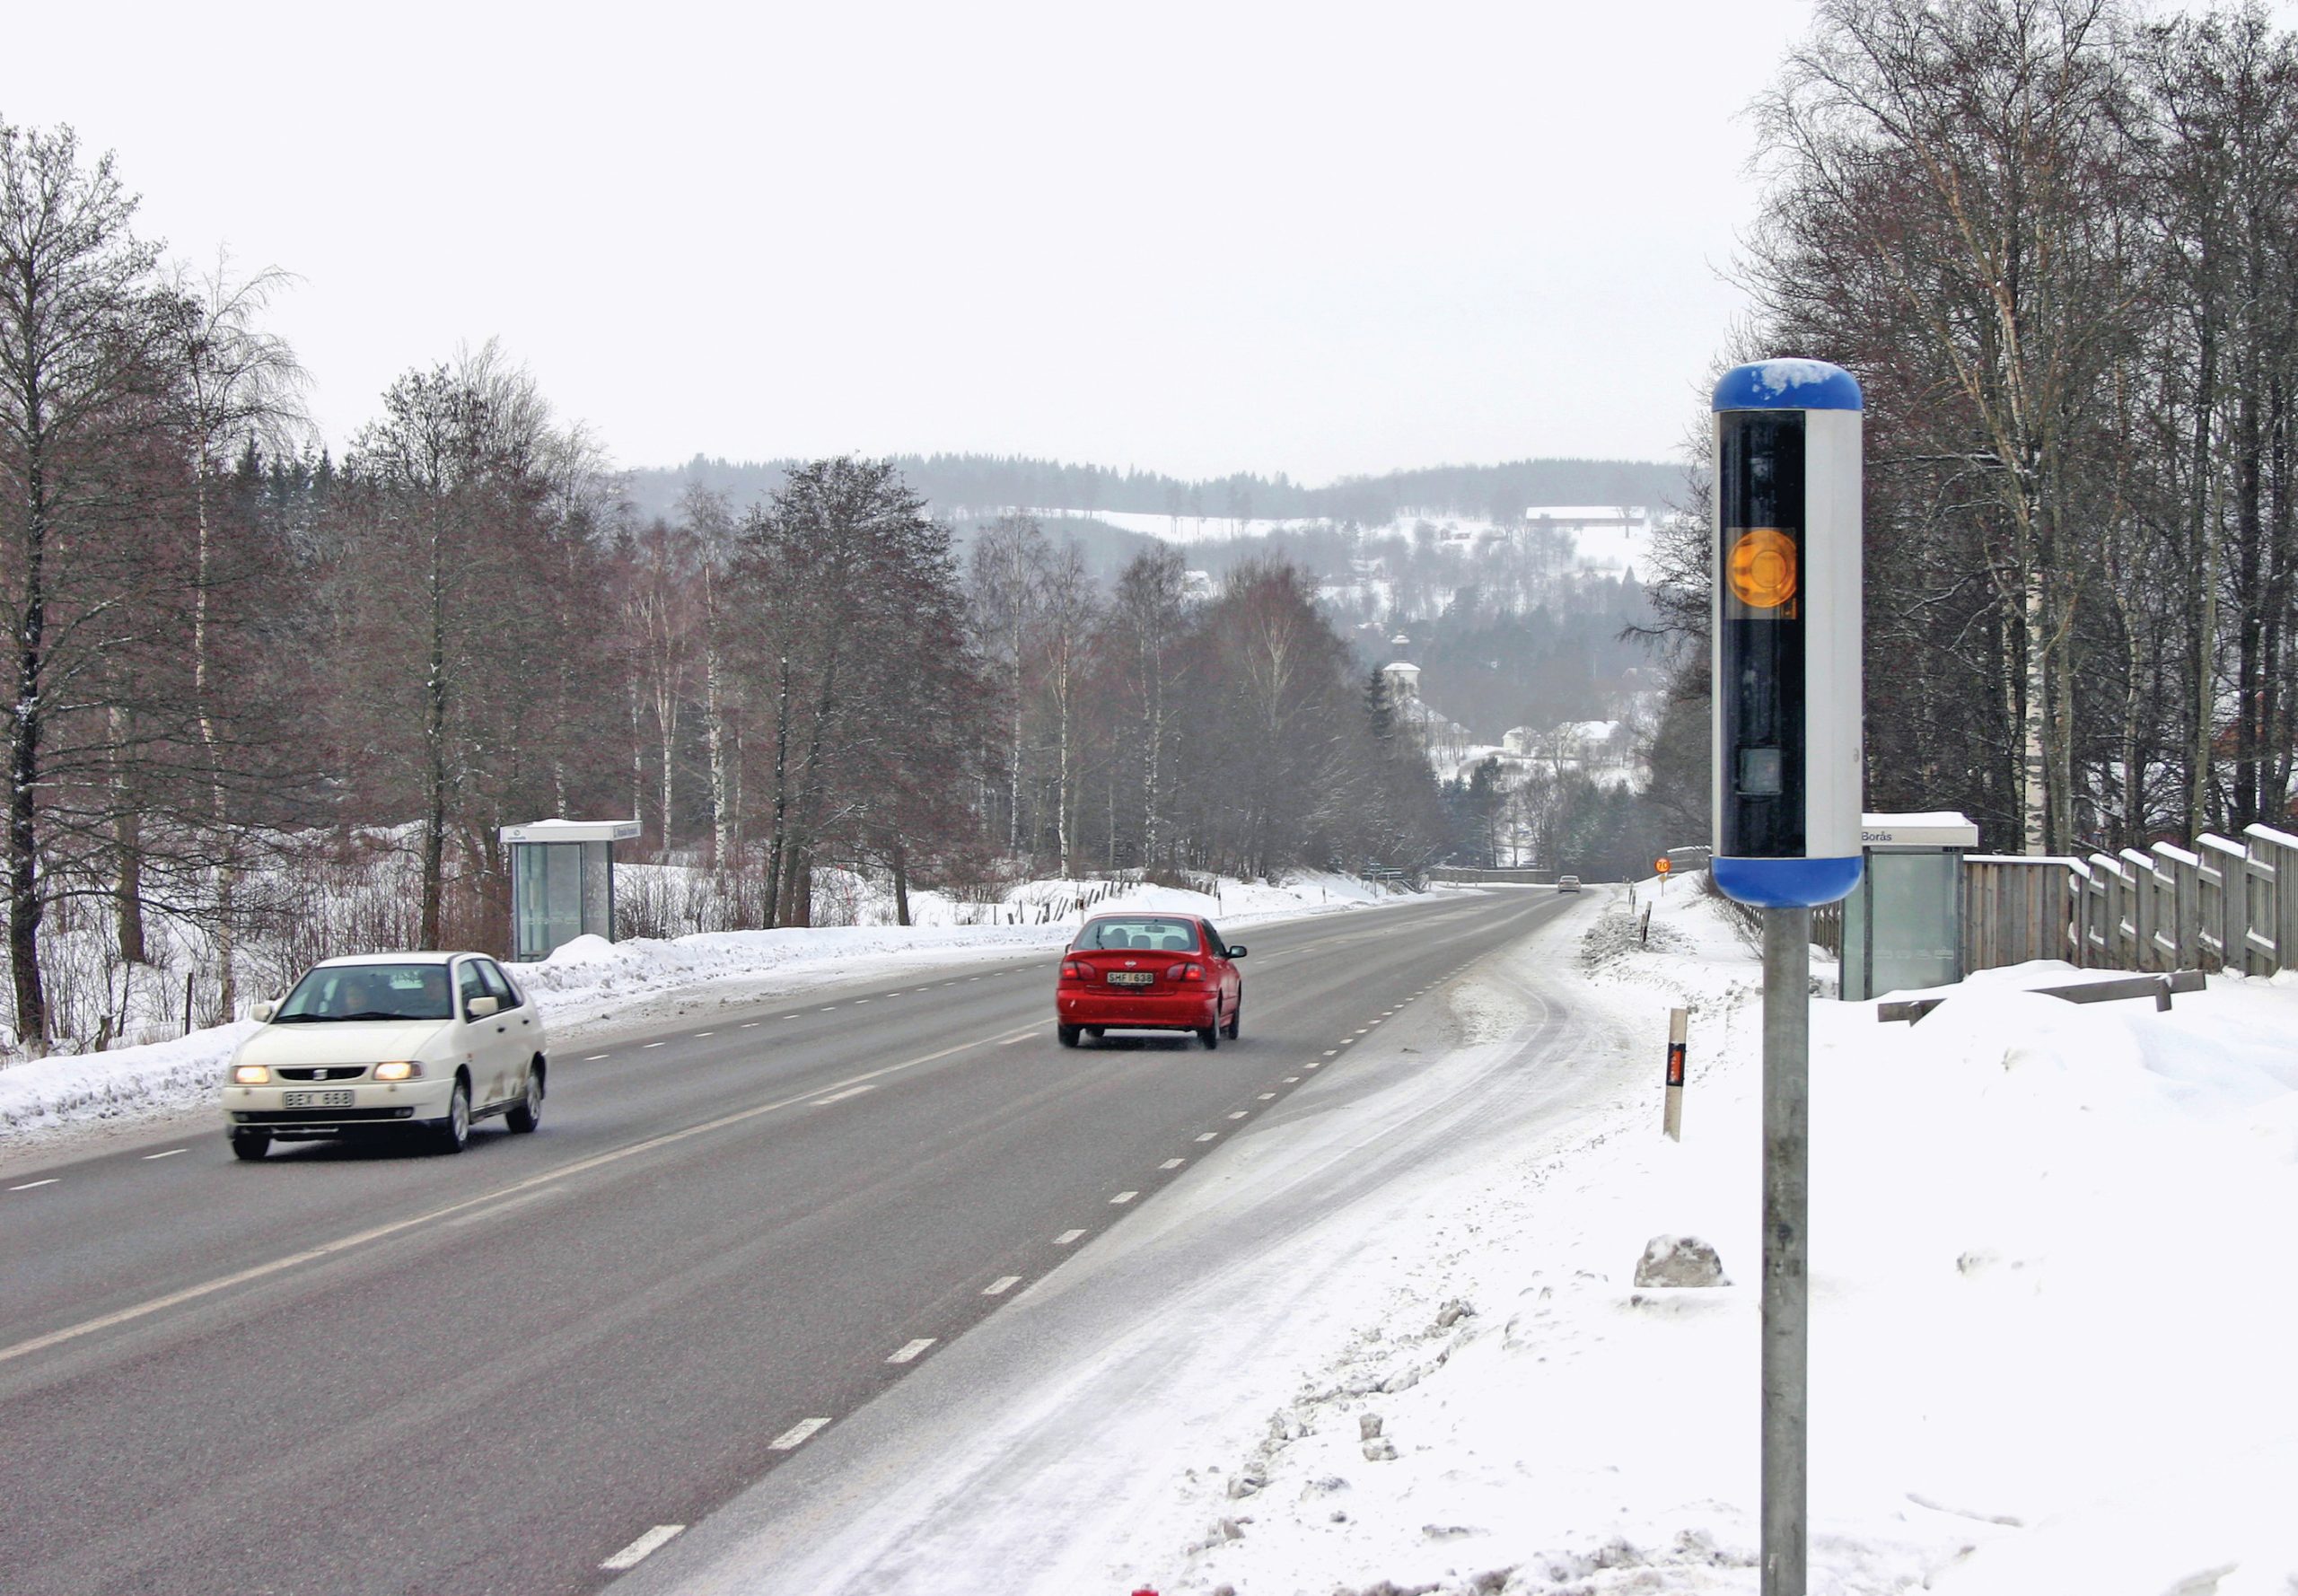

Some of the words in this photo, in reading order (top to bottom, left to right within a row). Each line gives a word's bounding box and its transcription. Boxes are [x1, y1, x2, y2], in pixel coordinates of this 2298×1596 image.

[1862, 830, 1892, 841] Borås
[1658, 862, 1667, 870] 70
[1109, 974, 1127, 982] SHF
[1134, 974, 1153, 982] 638
